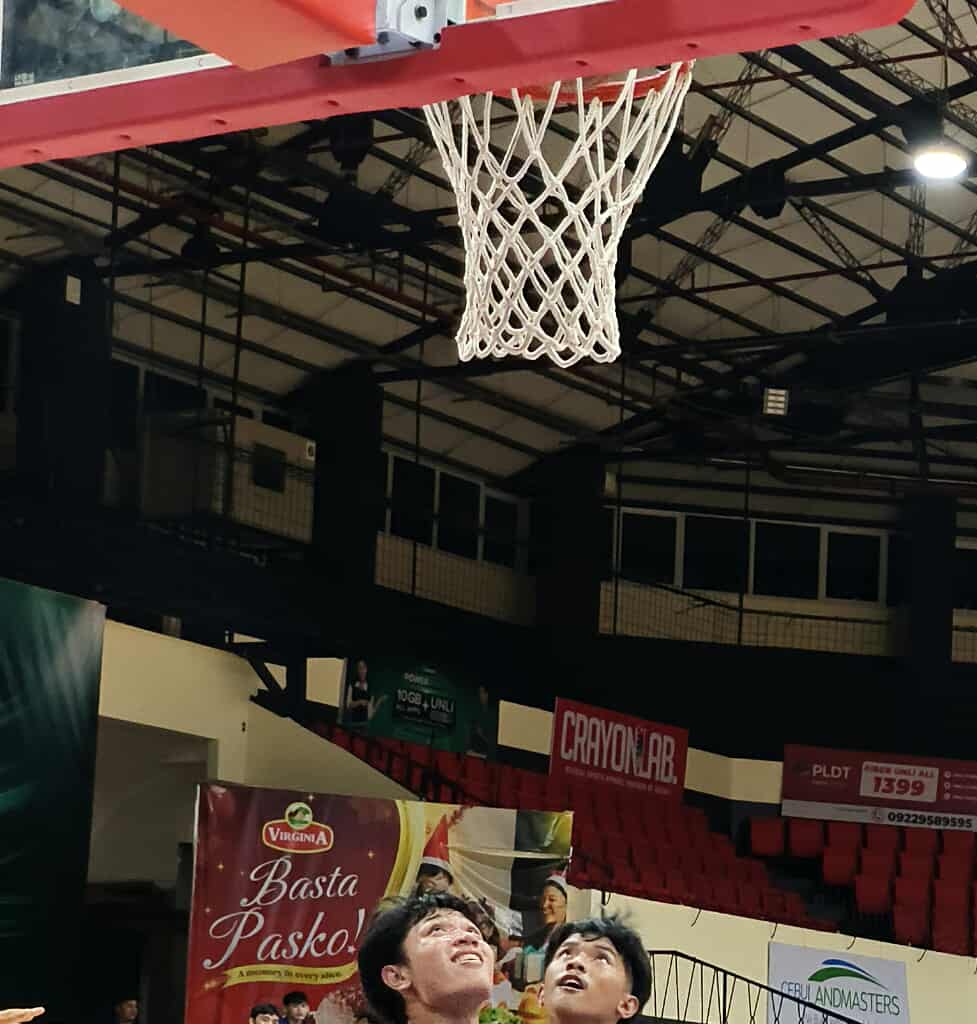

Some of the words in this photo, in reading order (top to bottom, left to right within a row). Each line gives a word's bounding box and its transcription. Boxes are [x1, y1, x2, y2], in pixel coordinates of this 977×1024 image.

[812, 763, 850, 779] PLDT
[873, 776, 925, 796] 1399
[240, 855, 359, 908] Basta
[203, 907, 366, 970] Pasko!
